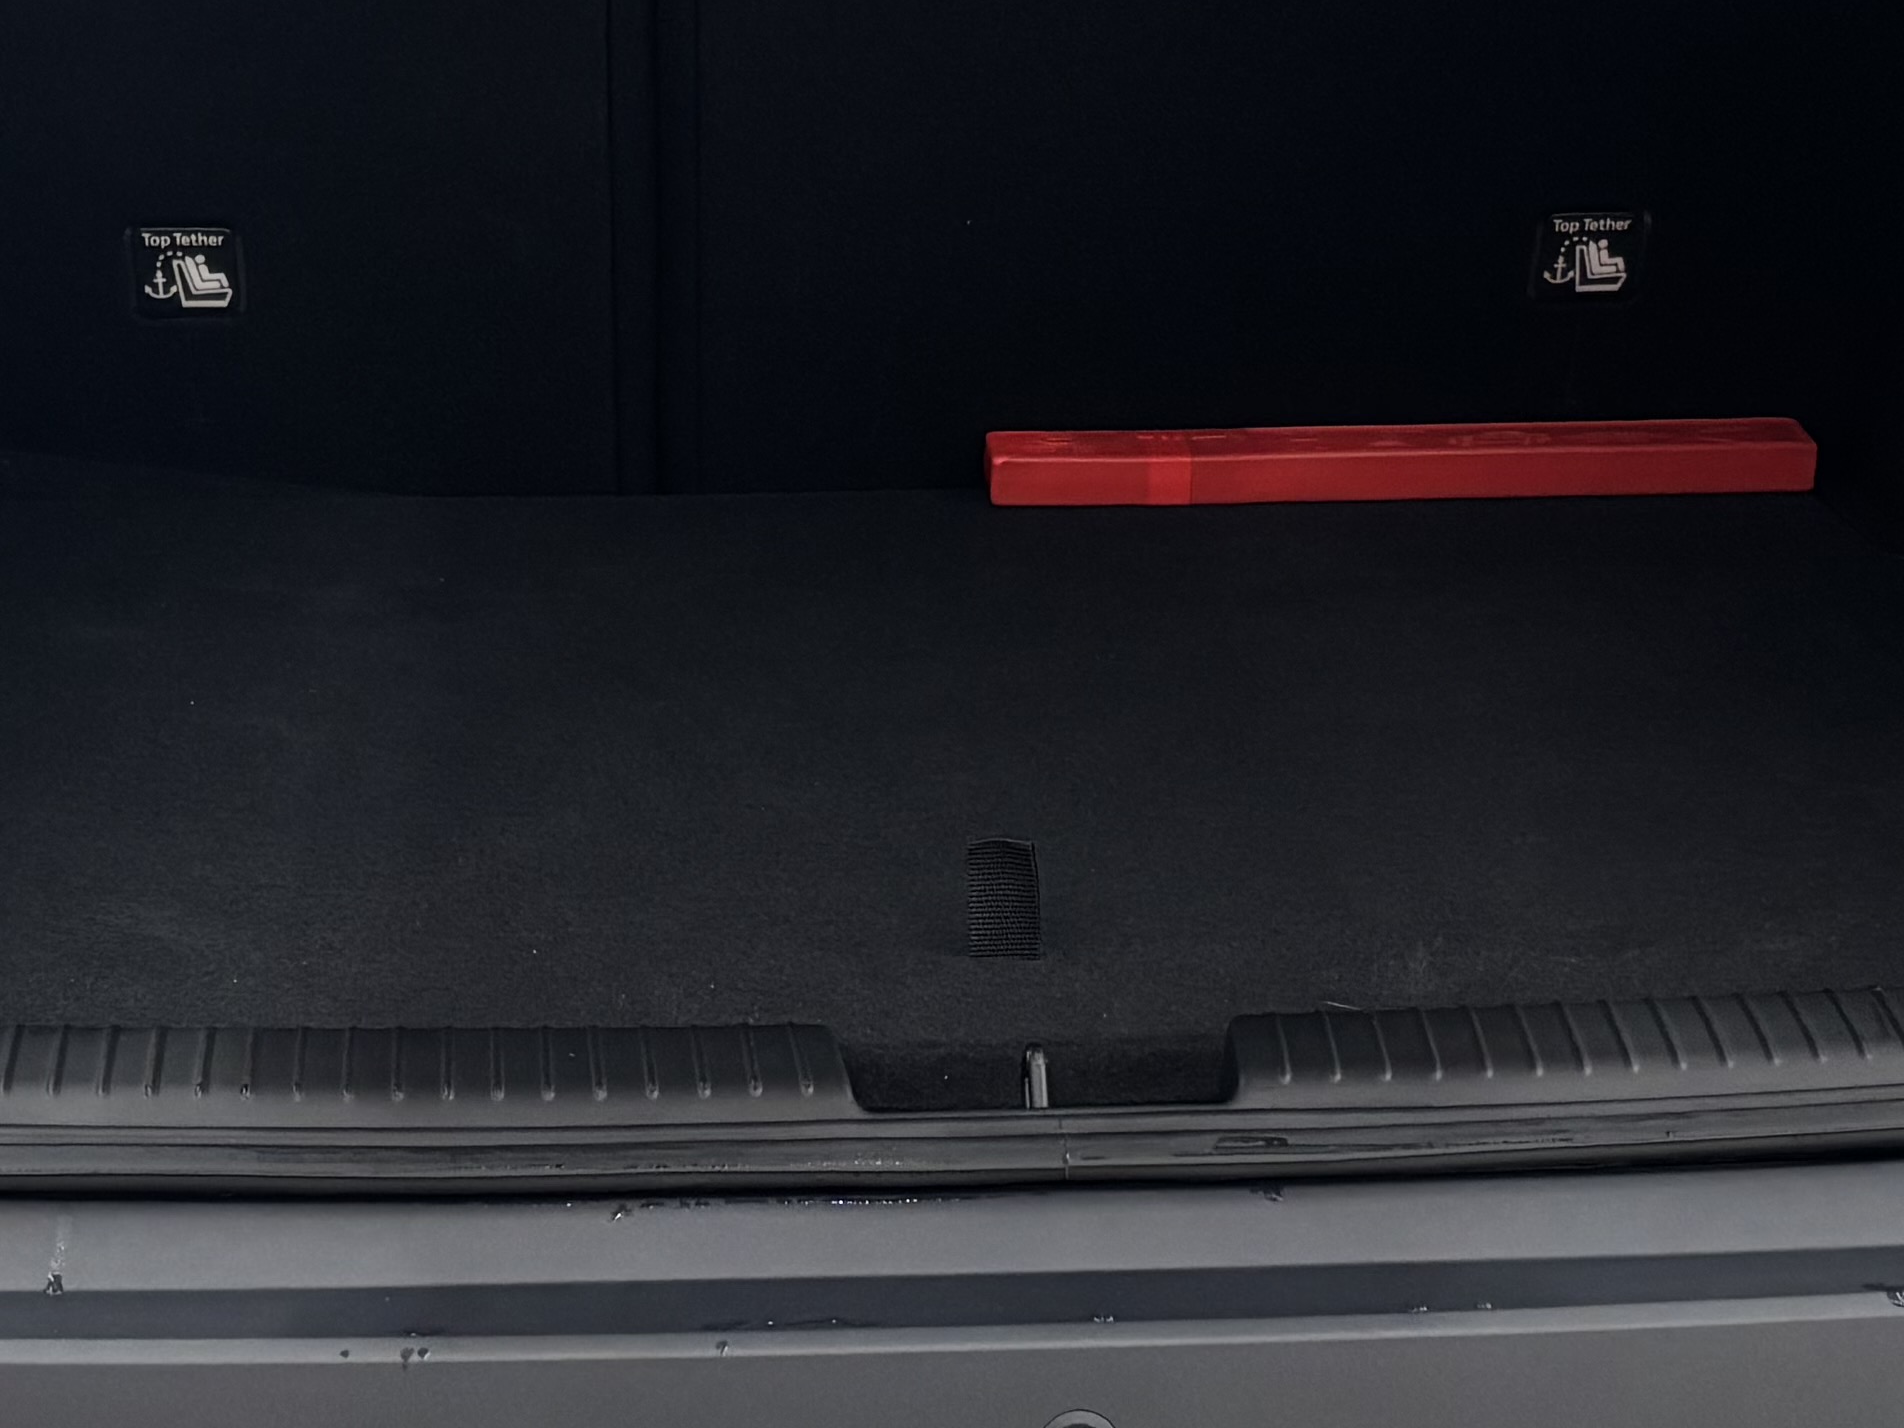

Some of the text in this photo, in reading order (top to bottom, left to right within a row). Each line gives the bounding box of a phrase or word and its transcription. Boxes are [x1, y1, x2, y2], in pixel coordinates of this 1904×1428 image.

[1553, 217, 1633, 234] Top Tether
[141, 232, 225, 249] Top Tether
